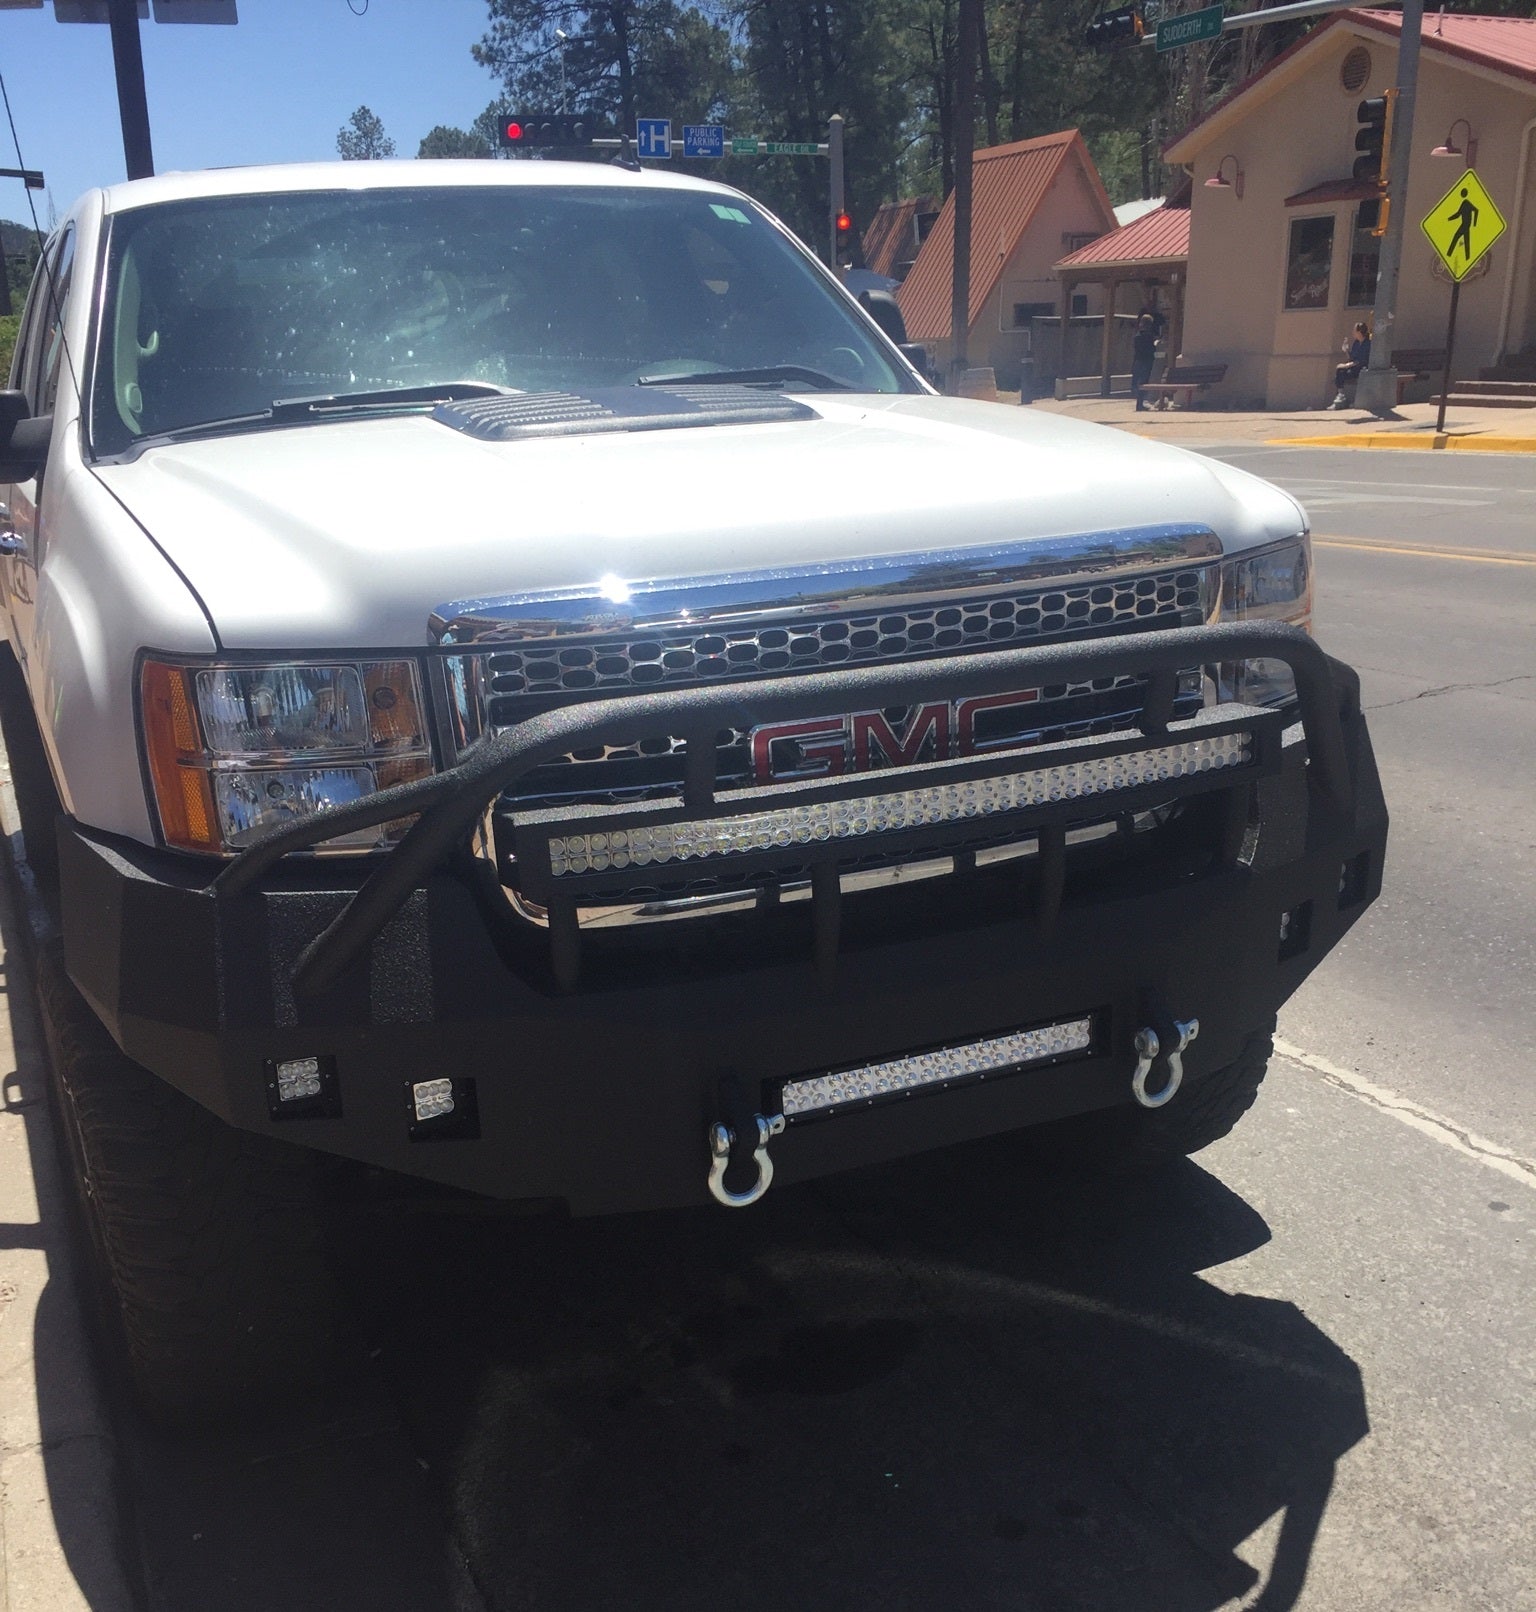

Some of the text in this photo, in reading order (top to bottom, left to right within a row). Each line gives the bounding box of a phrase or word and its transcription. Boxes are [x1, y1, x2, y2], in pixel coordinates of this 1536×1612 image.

[1163, 18, 1202, 42] SUDDERTH
[650, 125, 669, 152] H
[689, 127, 717, 137] PUBLIC
[687, 137, 720, 147] PARKING
[774, 143, 797, 153] EAGLE
[750, 687, 1041, 785] GMC
